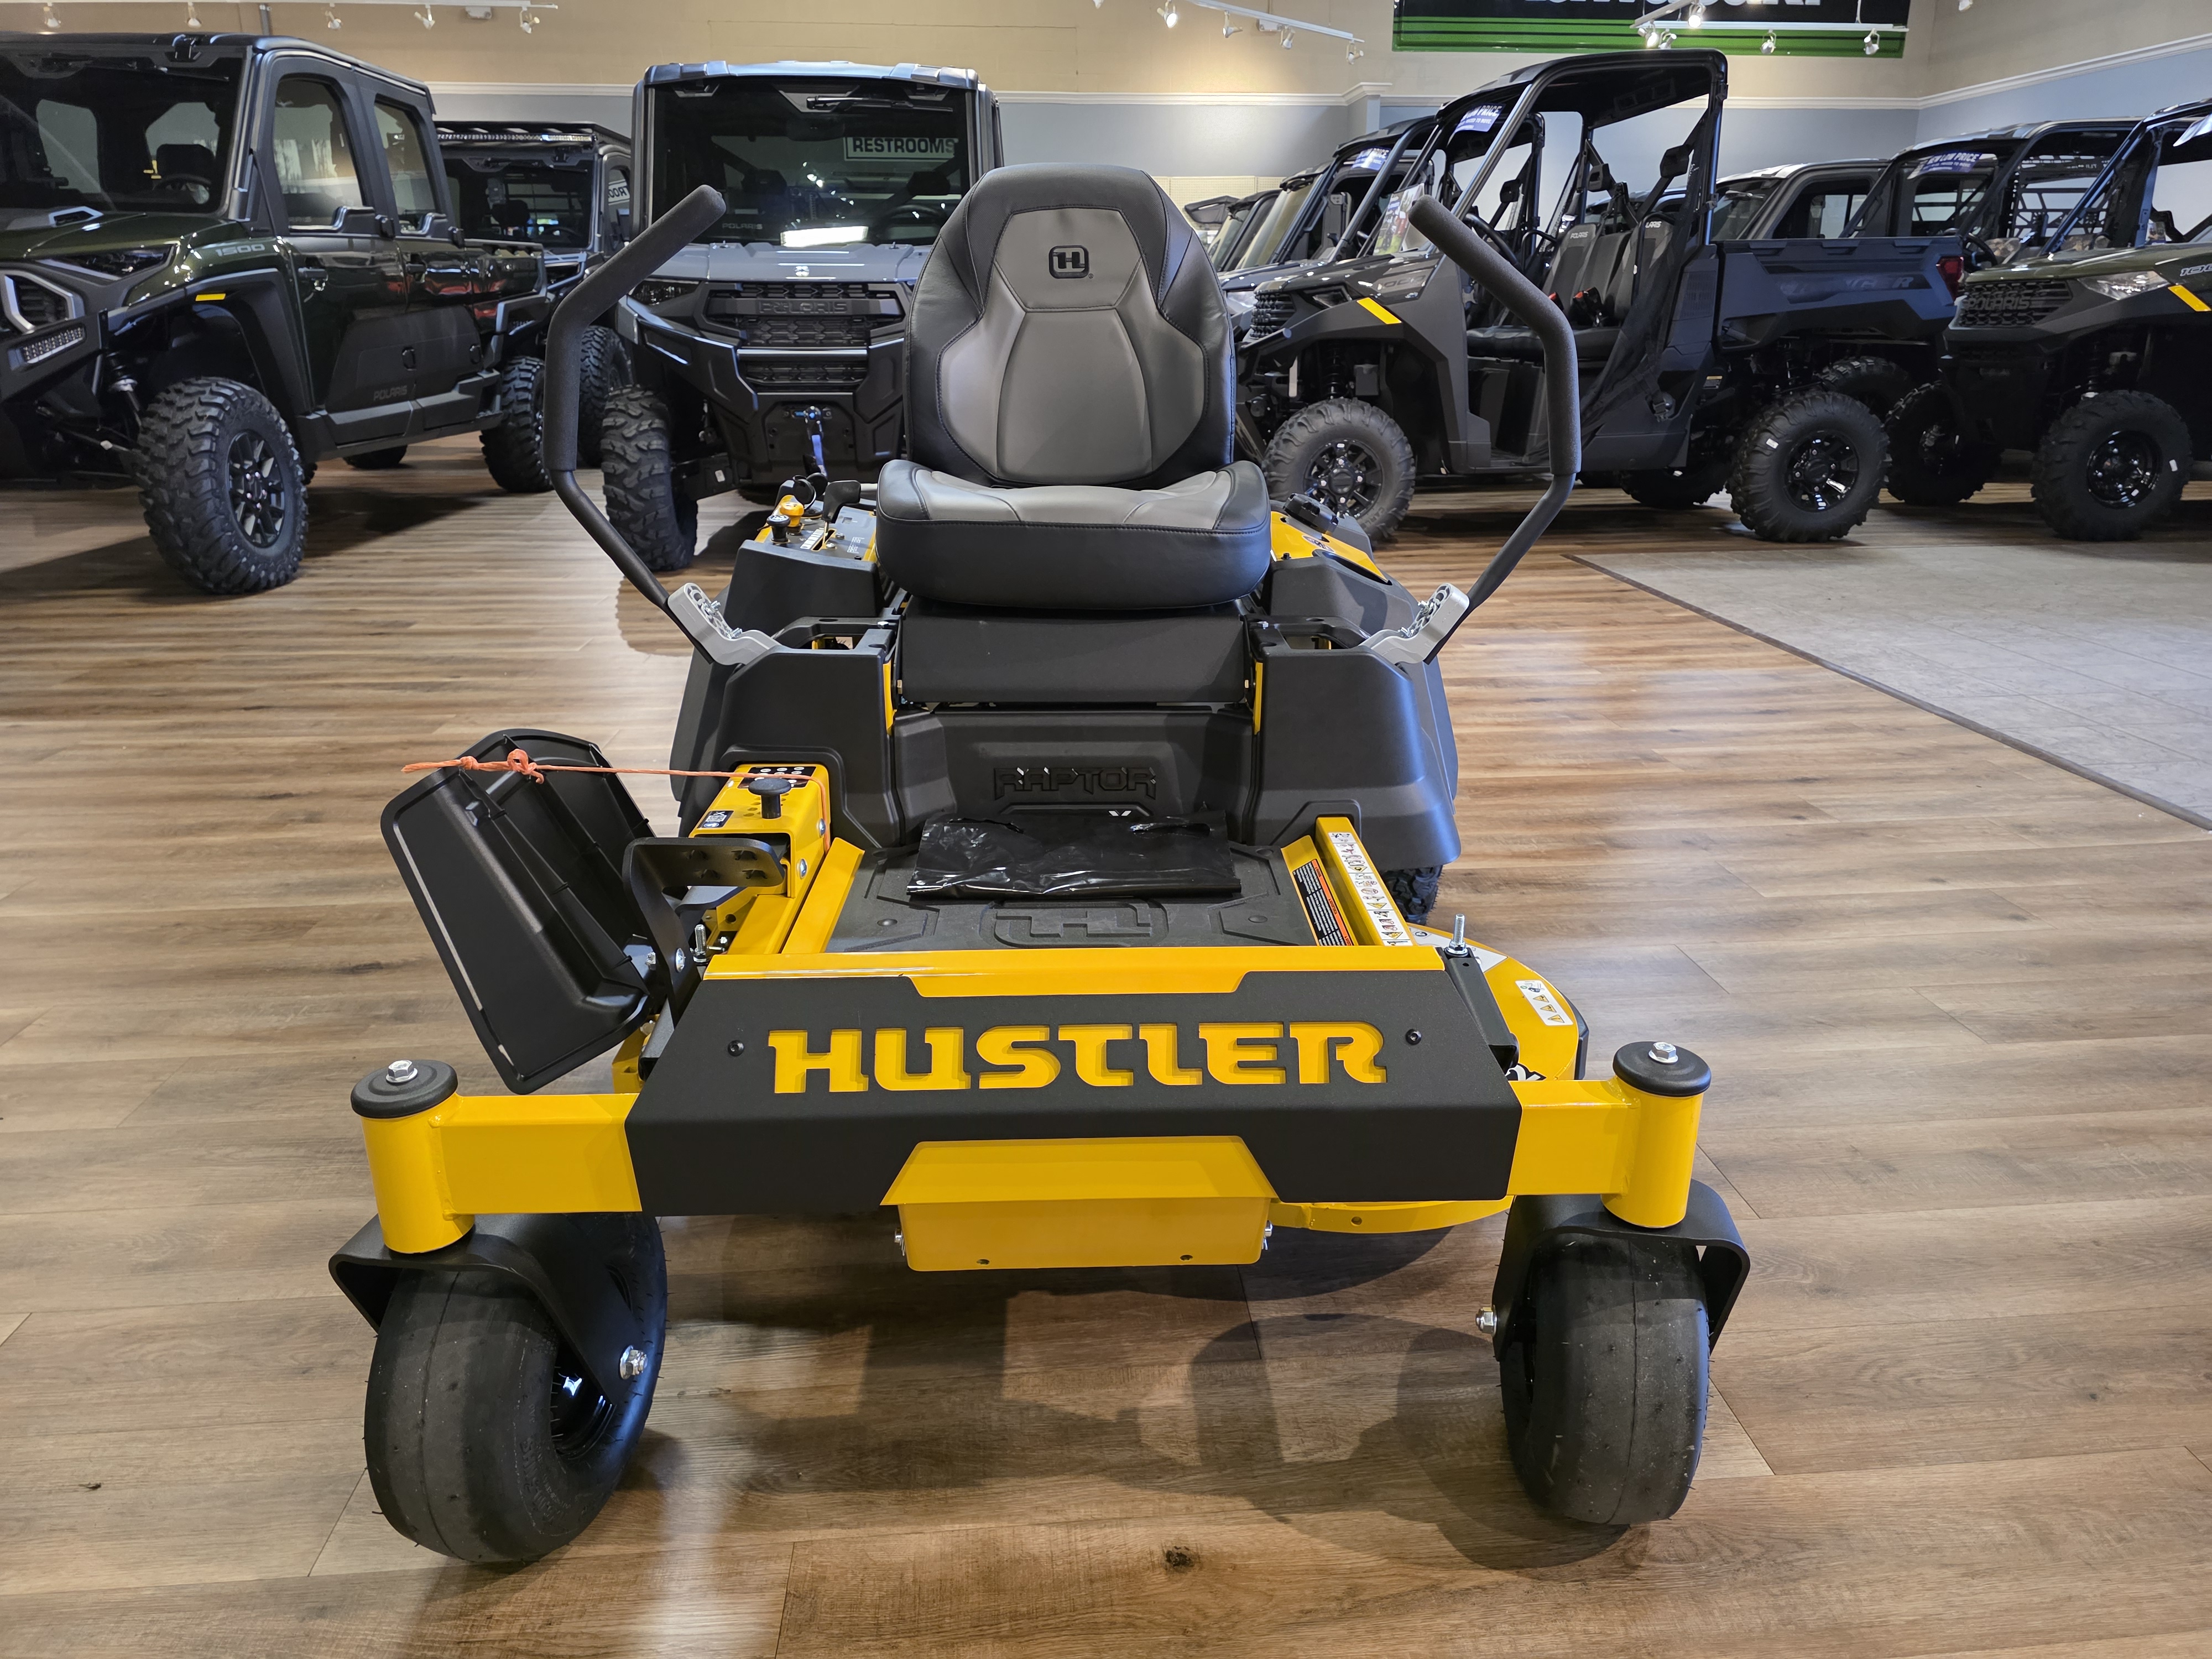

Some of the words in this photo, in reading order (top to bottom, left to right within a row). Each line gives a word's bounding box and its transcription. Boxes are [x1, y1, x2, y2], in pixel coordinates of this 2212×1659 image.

[215, 244, 265, 257] 1500
[759, 301, 849, 314] POLARIS
[373, 385, 408, 401] POLARIS
[994, 766, 1157, 801] RAPTOR
[768, 1022, 1387, 1094] HUSTLER
